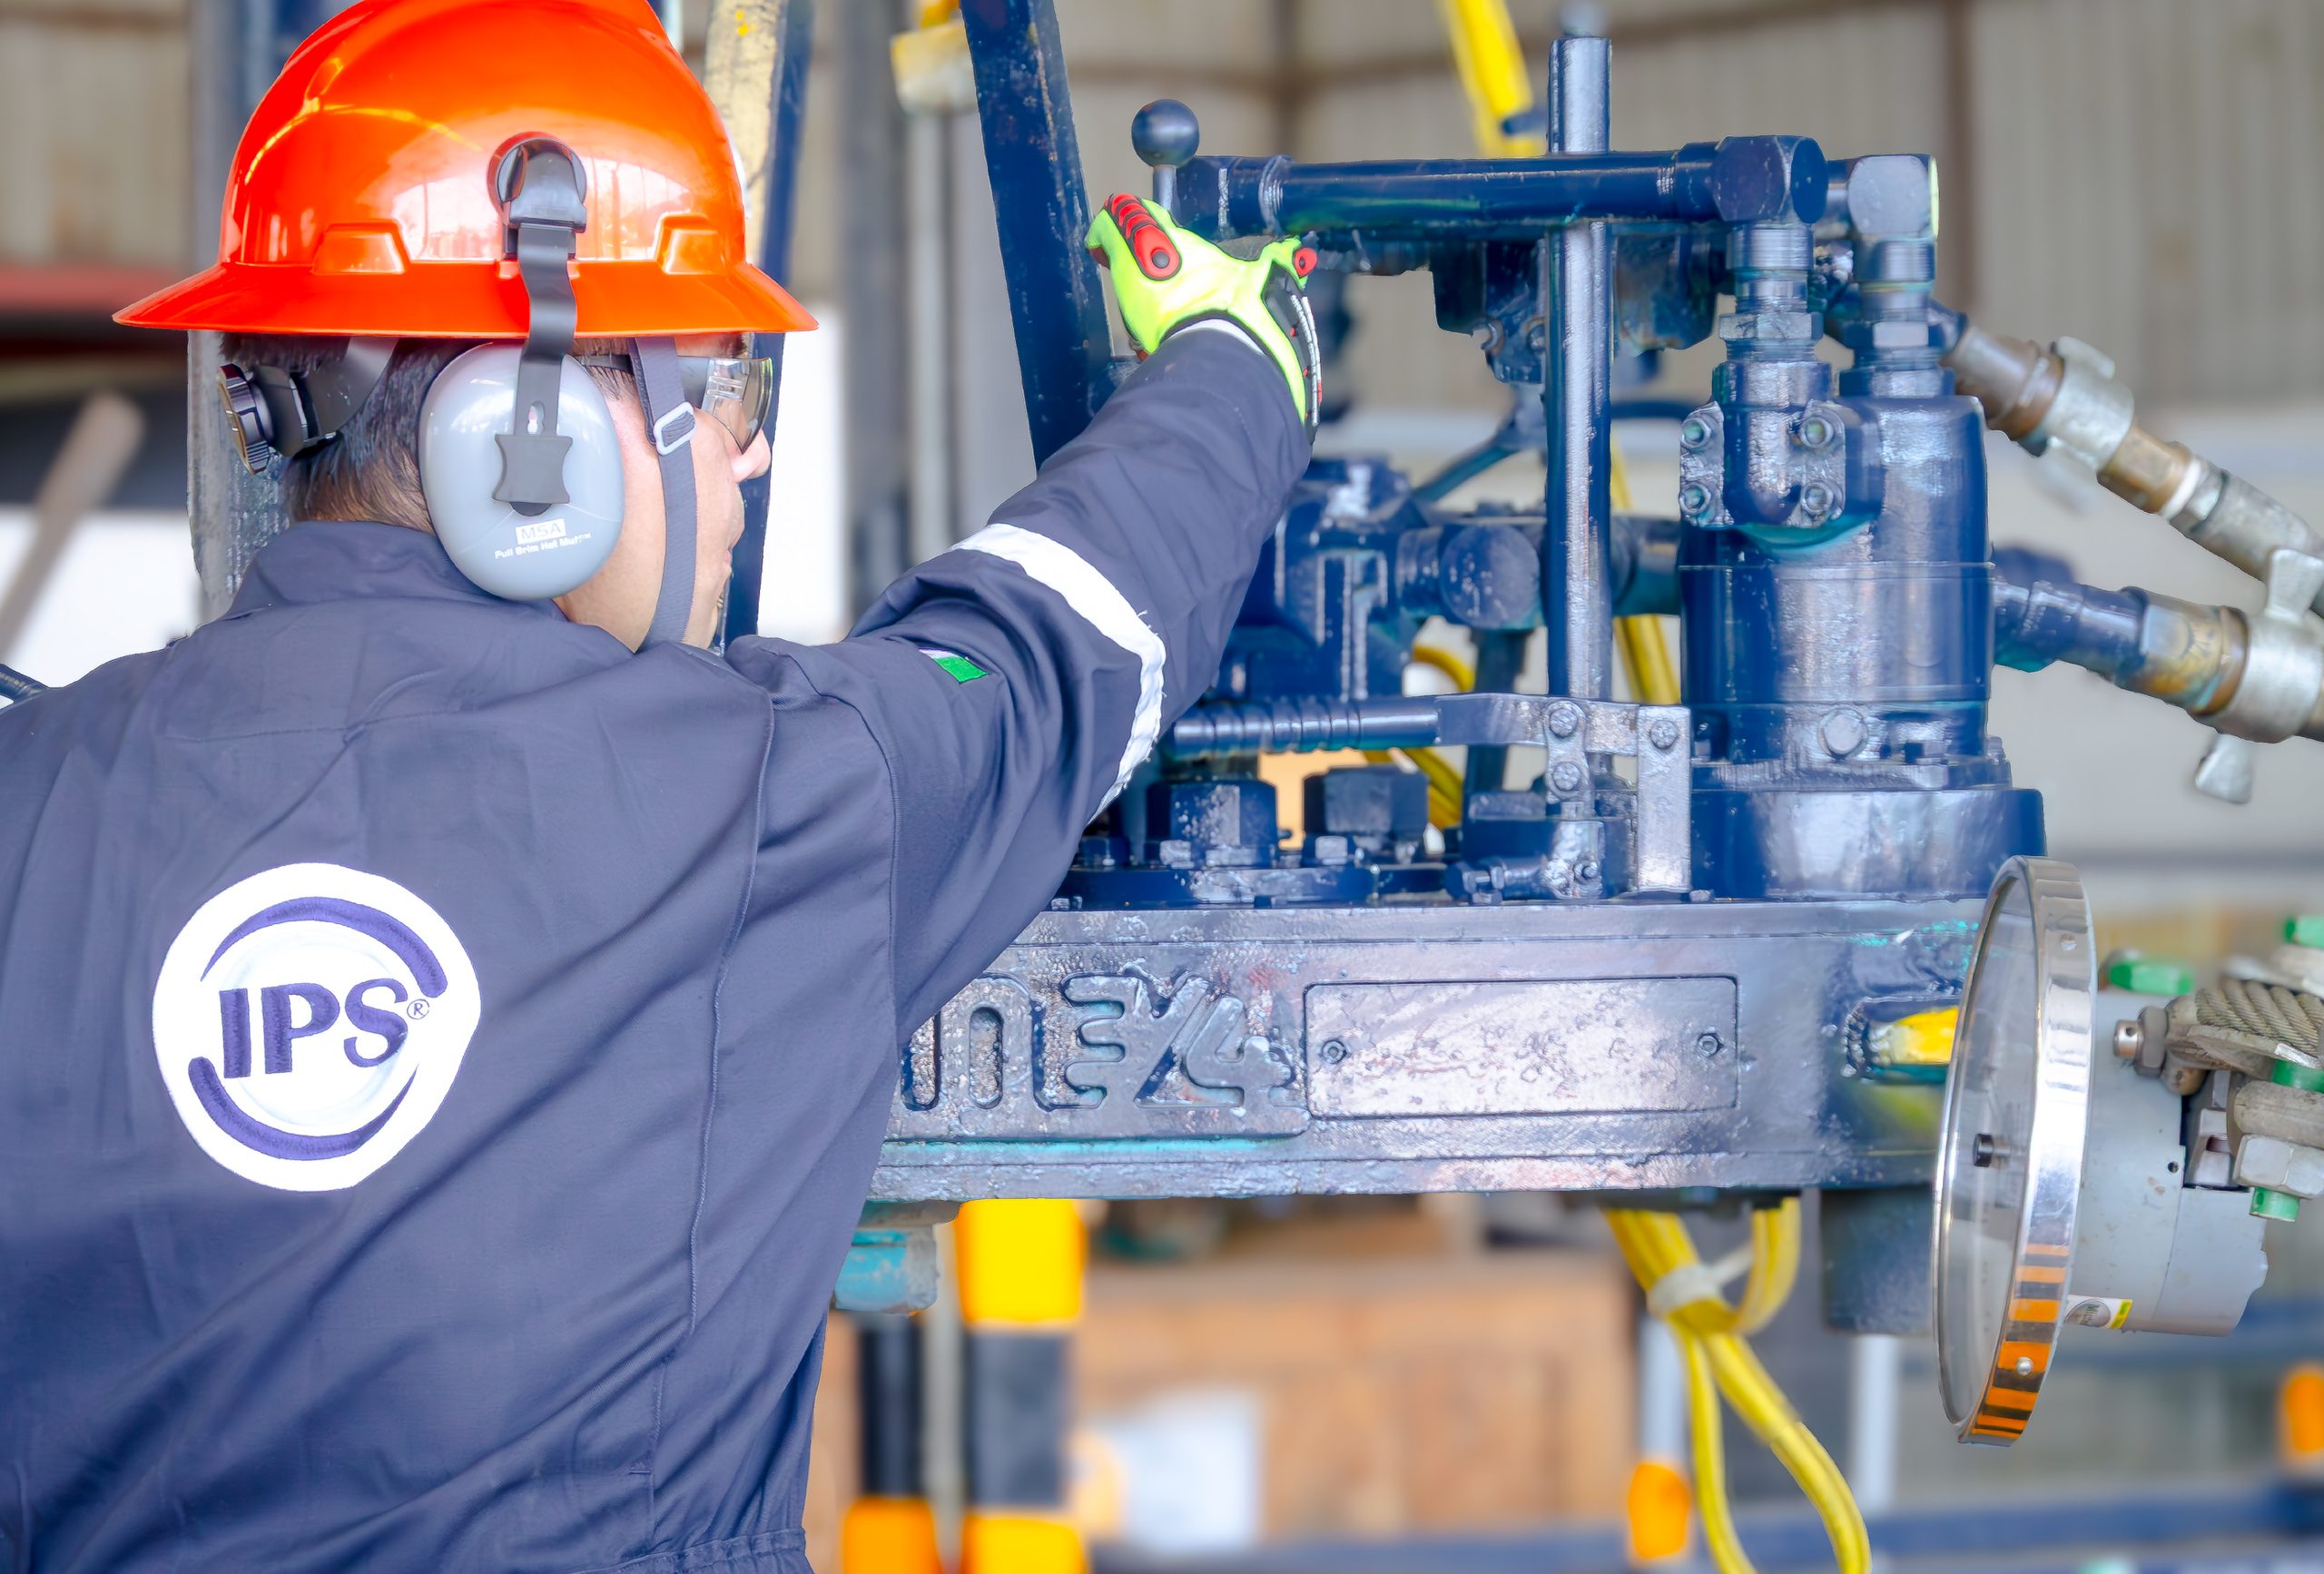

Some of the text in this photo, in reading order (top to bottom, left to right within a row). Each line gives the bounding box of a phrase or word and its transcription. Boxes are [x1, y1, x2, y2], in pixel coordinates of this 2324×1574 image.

[520, 522, 562, 540] MSA
[494, 548, 514, 559] Full
[515, 545, 539, 556] Brim
[540, 539, 558, 551] Hat
